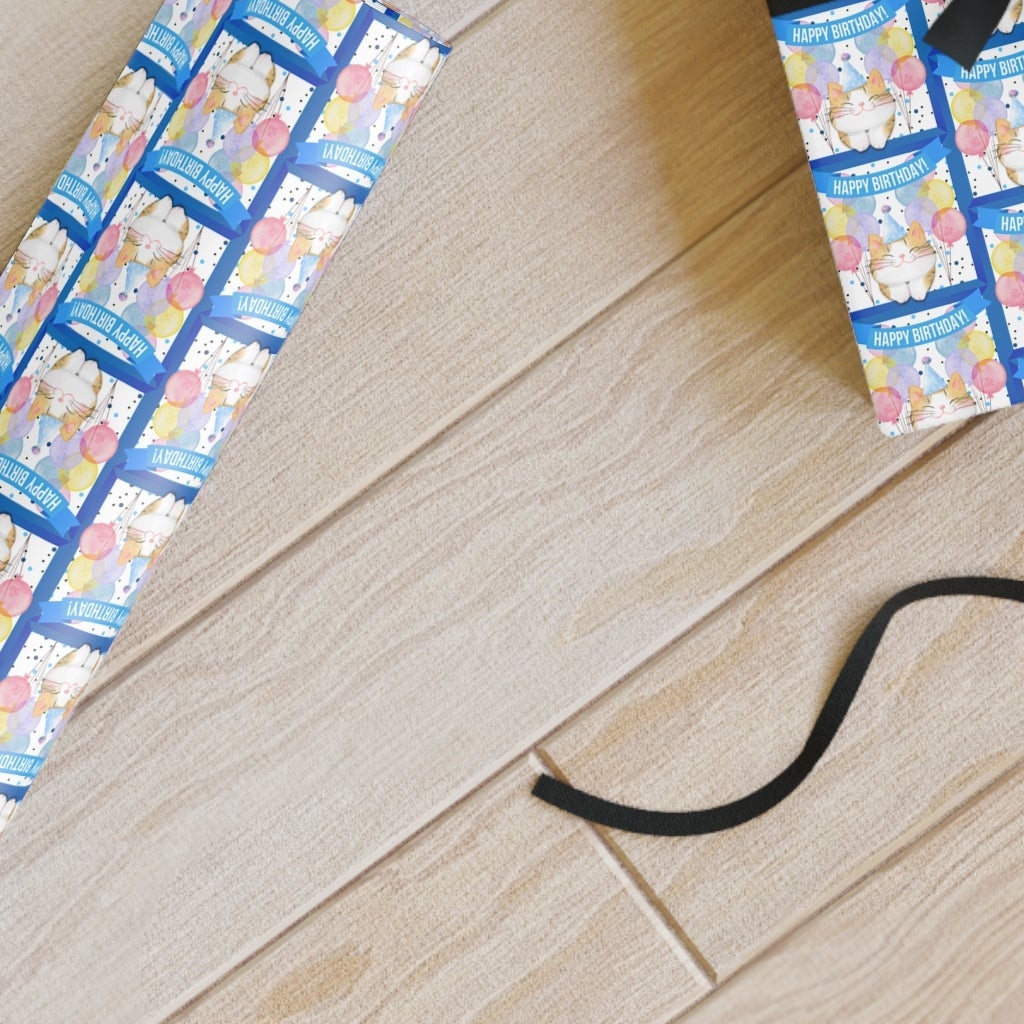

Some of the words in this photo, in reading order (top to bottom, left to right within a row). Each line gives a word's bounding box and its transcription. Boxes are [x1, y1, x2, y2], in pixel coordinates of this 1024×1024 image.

[286, 16, 320, 51] HAPPY
[793, 26, 828, 42] HAPPY
[832, 5, 890, 39] BIRTHDAY!
[199, 170, 234, 205] HAPPY
[833, 178, 868, 195] HAPPY
[872, 158, 930, 192] BIRTHDAY!
[112, 324, 148, 358] HAPPY
[874, 330, 910, 346] HAPPY
[912, 309, 970, 343] BIRTHDAY!
[25, 477, 62, 512] HAPPY
